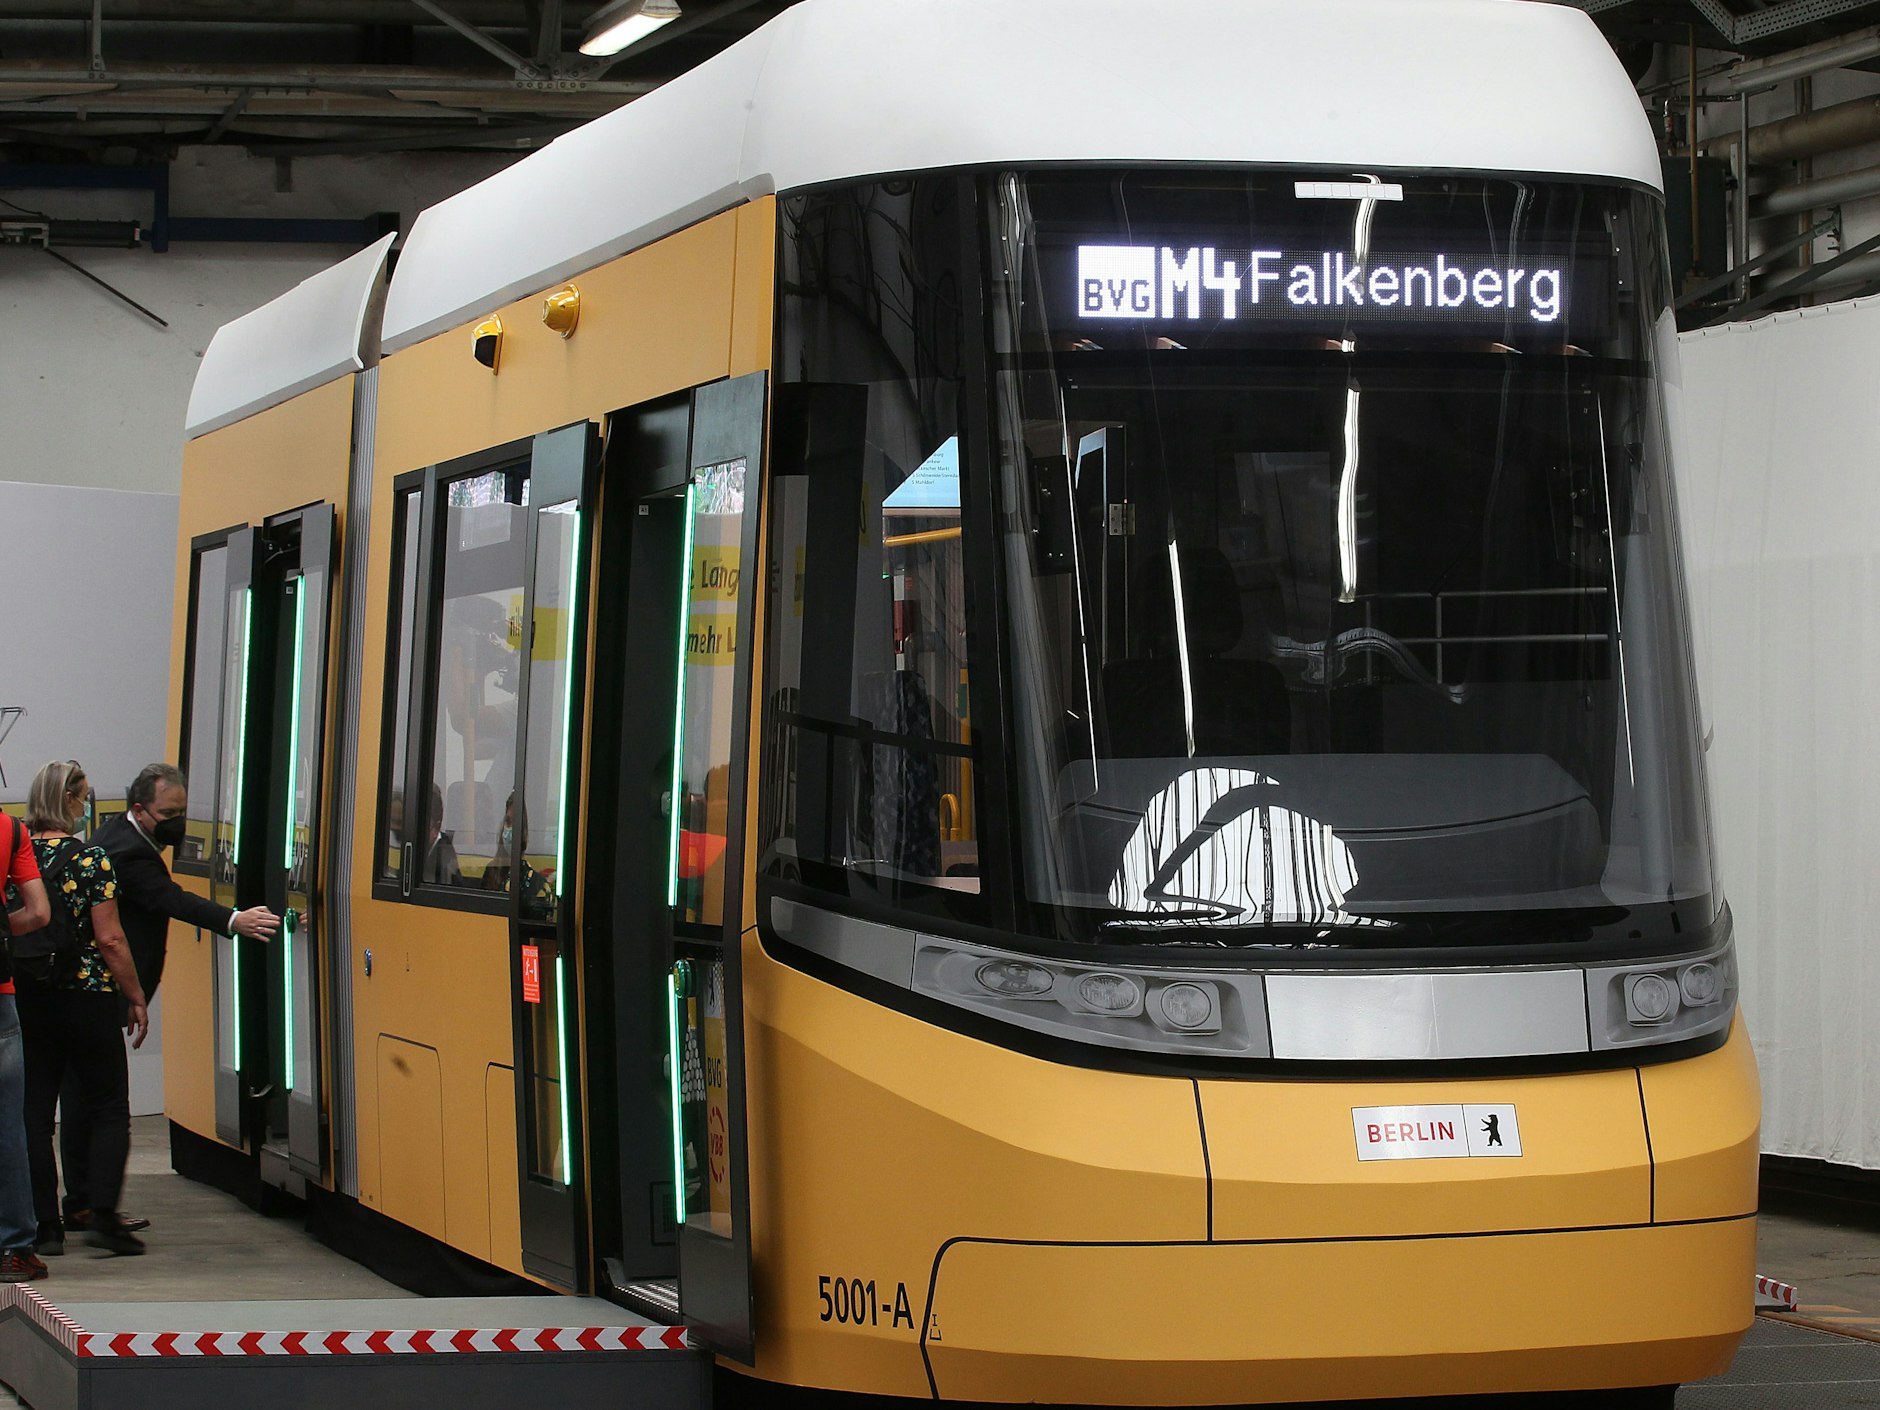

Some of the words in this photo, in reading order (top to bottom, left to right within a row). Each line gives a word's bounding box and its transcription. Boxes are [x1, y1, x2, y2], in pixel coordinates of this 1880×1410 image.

[1083, 278, 1151, 312] BVG
[1161, 247, 1241, 319] M4
[1250, 251, 1560, 322] Falkenberg
[707, 1057, 722, 1088] BVG
[1367, 1121, 1455, 1143] BERLIN
[819, 1275, 914, 1329] 5001-A
